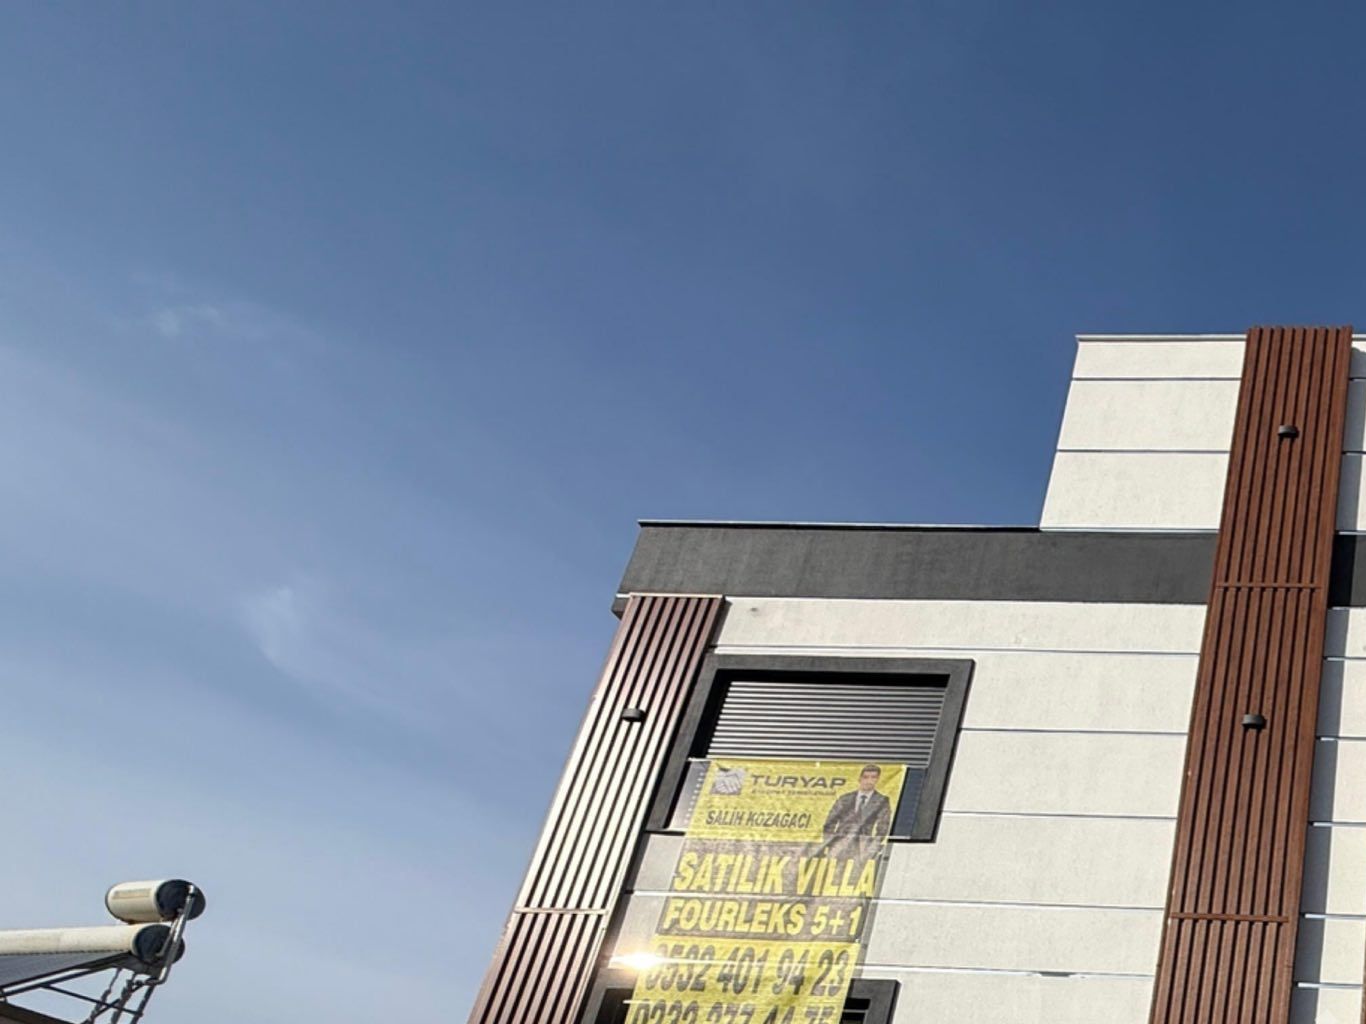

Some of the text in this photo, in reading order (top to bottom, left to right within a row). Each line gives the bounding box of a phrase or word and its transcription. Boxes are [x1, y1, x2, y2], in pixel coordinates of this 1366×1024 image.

[751, 774, 846, 789] TURYAP
[673, 851, 793, 894] SATILIK
[663, 898, 863, 936] FOURLEKS 5+1
[716, 946, 770, 995] 401
[772, 948, 810, 996] 94
[810, 949, 849, 998] 23
